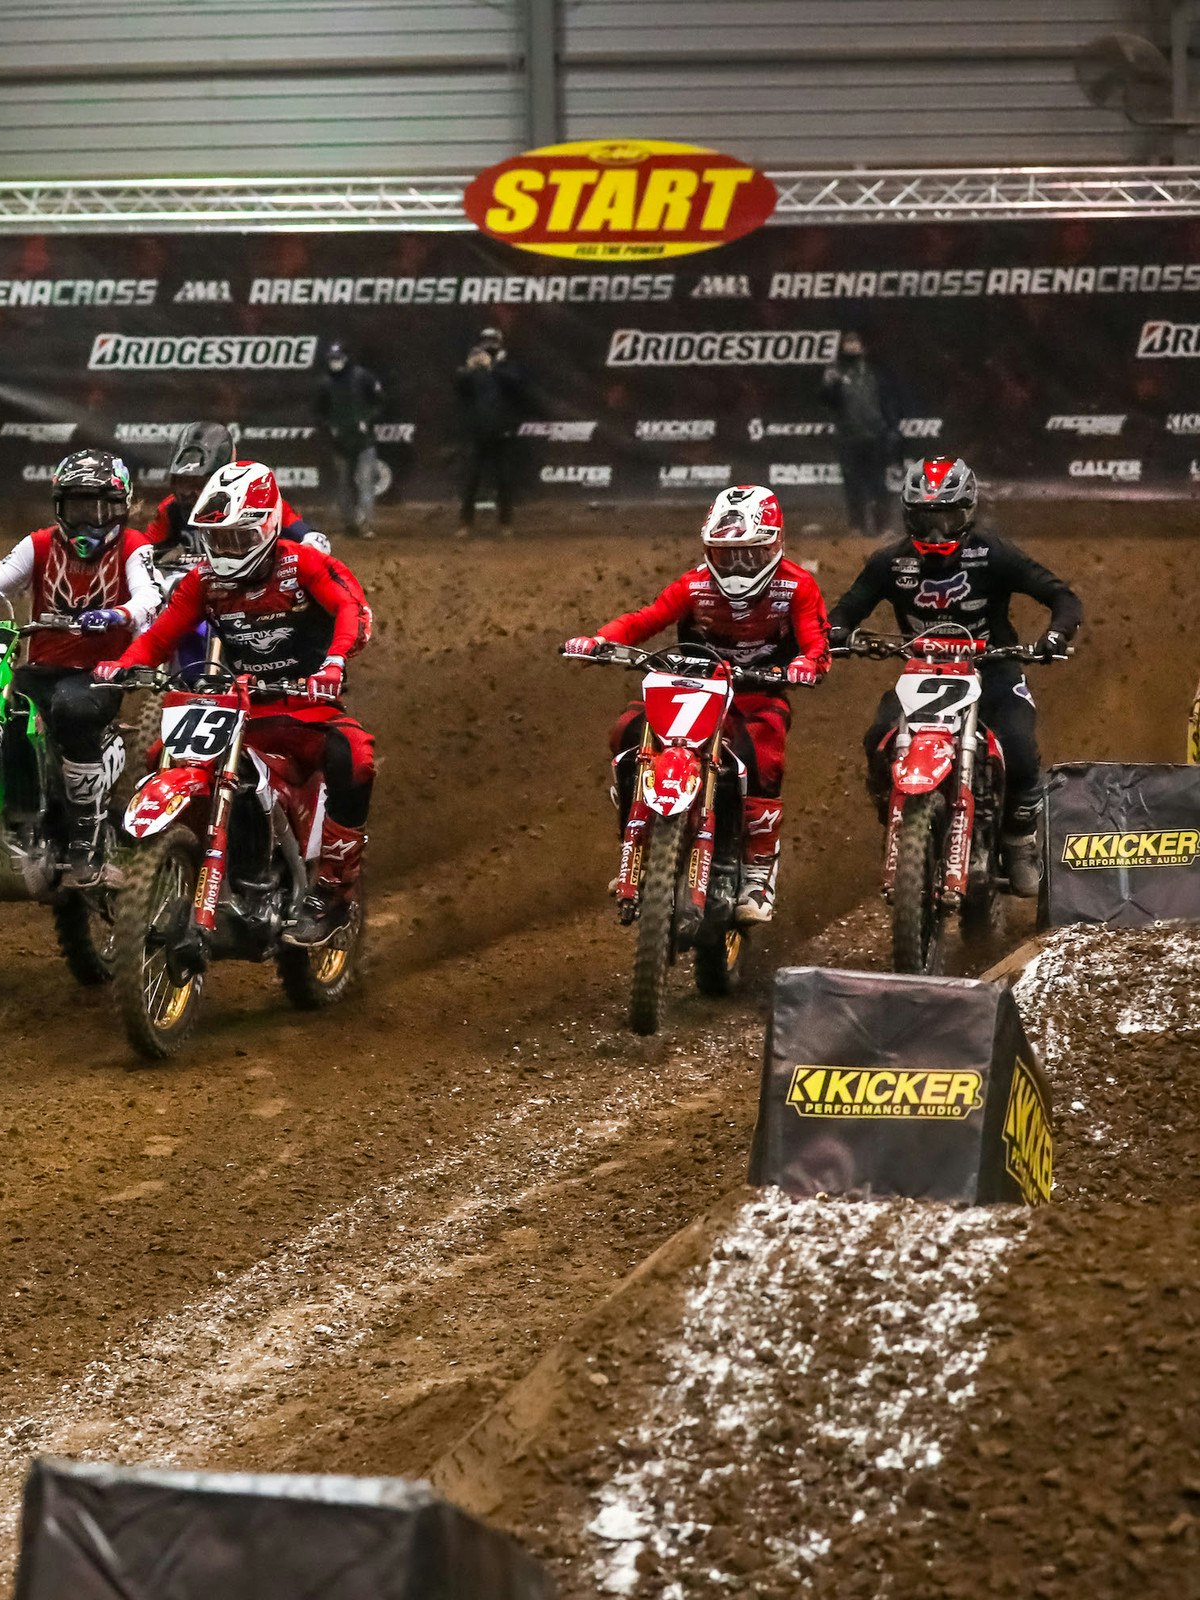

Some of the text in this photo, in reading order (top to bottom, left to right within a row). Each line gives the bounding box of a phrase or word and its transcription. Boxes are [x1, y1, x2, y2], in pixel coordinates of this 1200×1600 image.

[485, 168, 755, 233] START
[250, 277, 458, 304] ARENACROSS
[460, 274, 675, 304] ARENACROSS
[768, 270, 985, 299] ARENACROSS
[986, 265, 1200, 295] ARENACROSS
[93, 335, 314, 367] BRIDGESTONE
[611, 331, 838, 364] BRIDGESTONE
[243, 658, 299, 672] HONDA
[666, 691, 712, 737] 1
[905, 677, 971, 724] 2
[164, 707, 239, 756] 43
[946, 811, 965, 881] Hoosier
[1075, 855, 1189, 867] PERFORMANCE AUDIO
[1088, 831, 1198, 859] KICKER
[697, 849, 712, 896] Hoosier
[824, 1070, 979, 1105] KICKER
[805, 1103, 962, 1116] PERFORMANCE AUDIO
